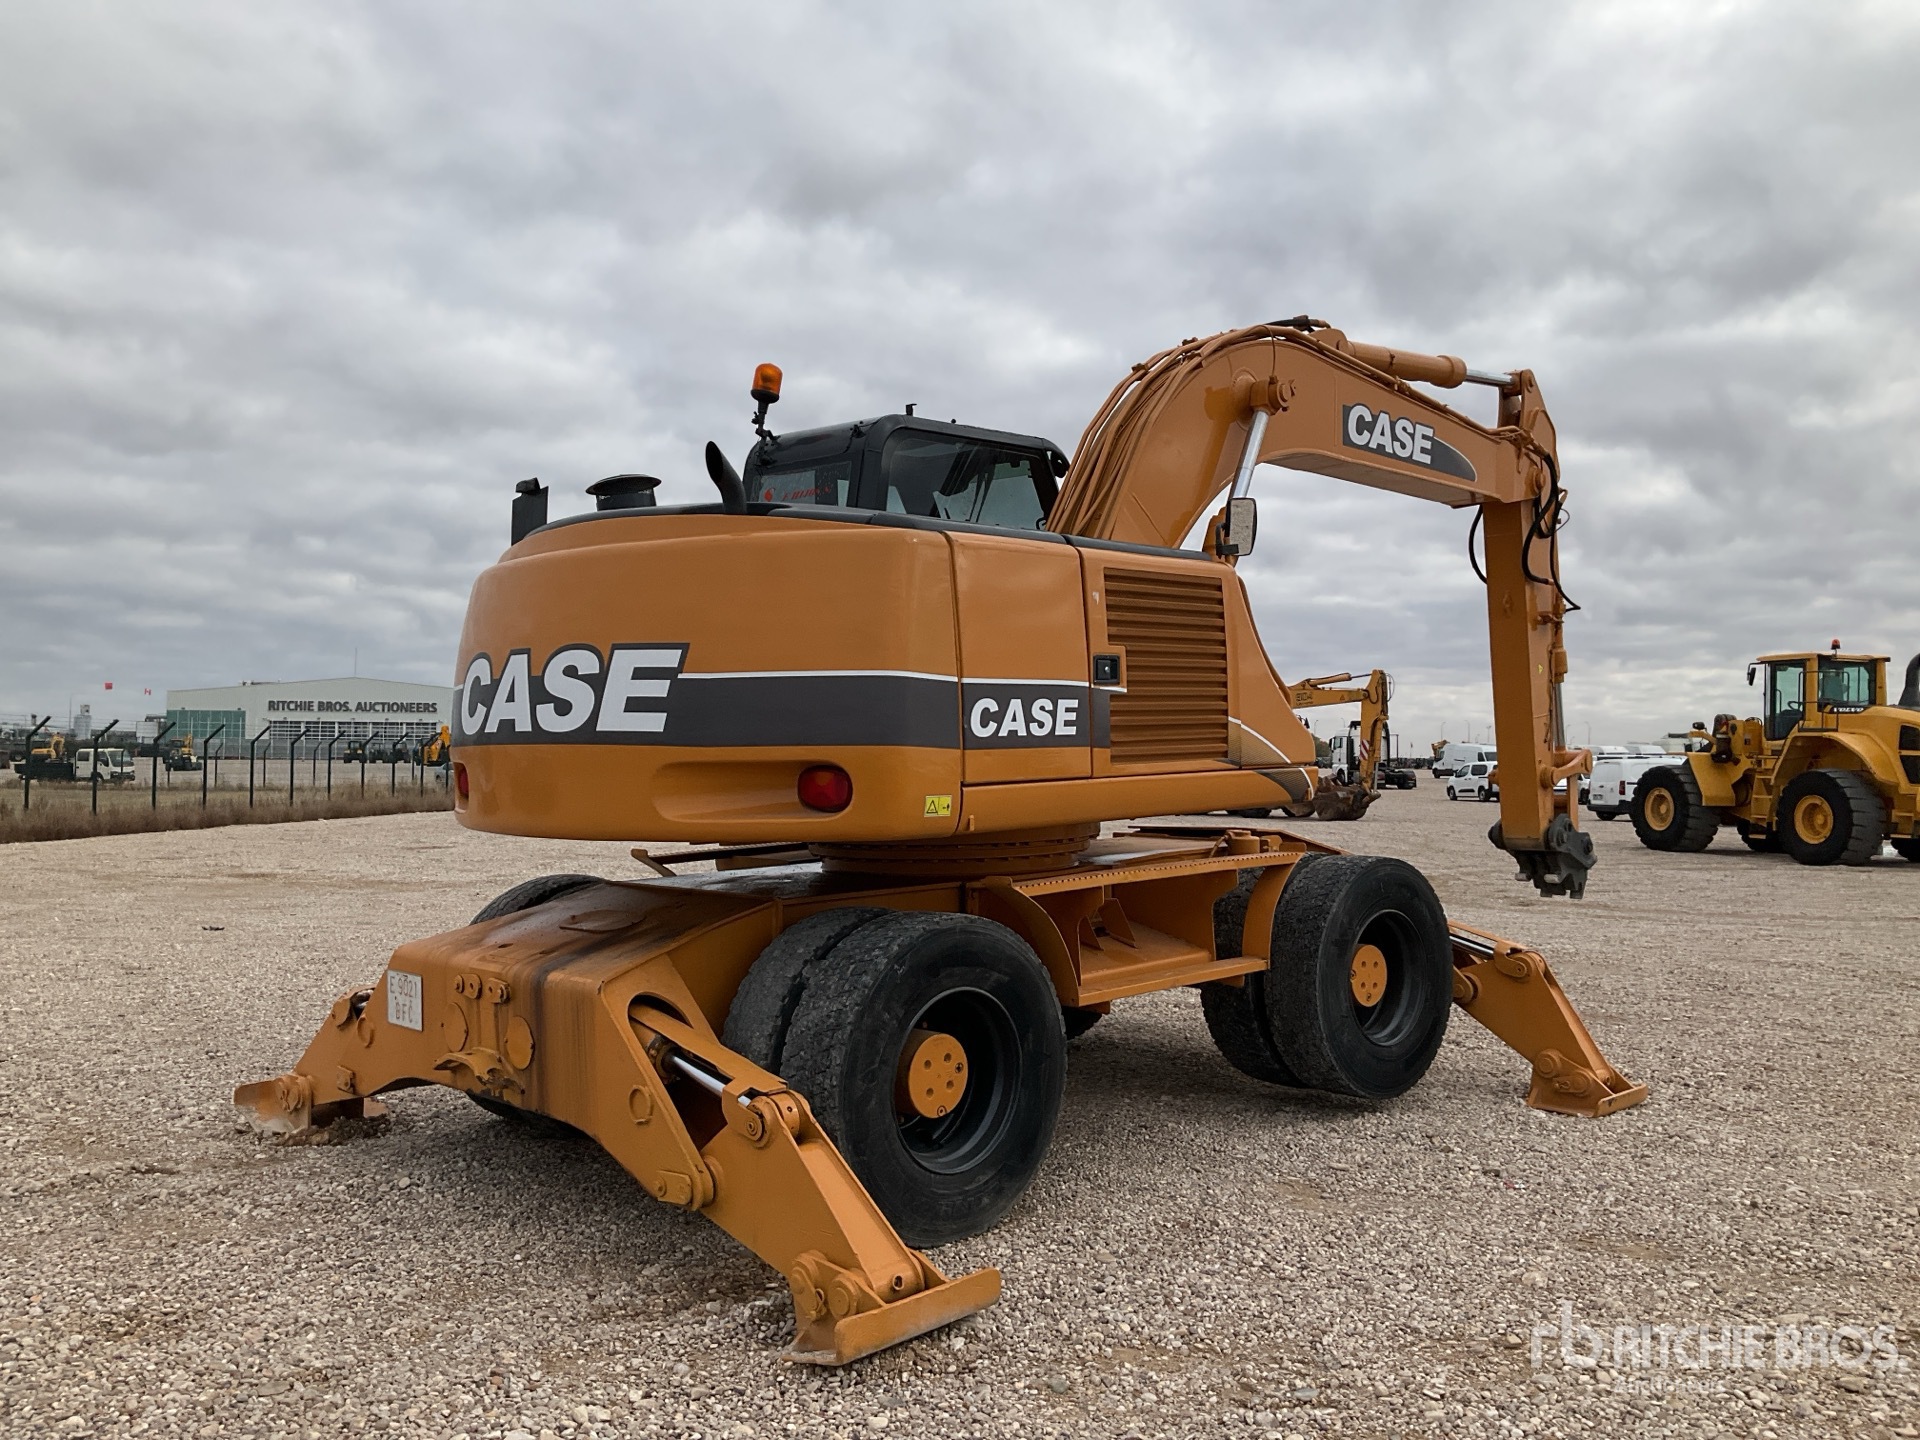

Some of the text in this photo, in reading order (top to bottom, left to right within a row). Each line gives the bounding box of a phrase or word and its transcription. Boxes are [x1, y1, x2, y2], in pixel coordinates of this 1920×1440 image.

[1348, 405, 1434, 465] CASE
[268, 700, 438, 713] RITCHIE BROS. AUCTIONEERS
[461, 649, 683, 736] CASE
[970, 698, 1079, 738] CASE
